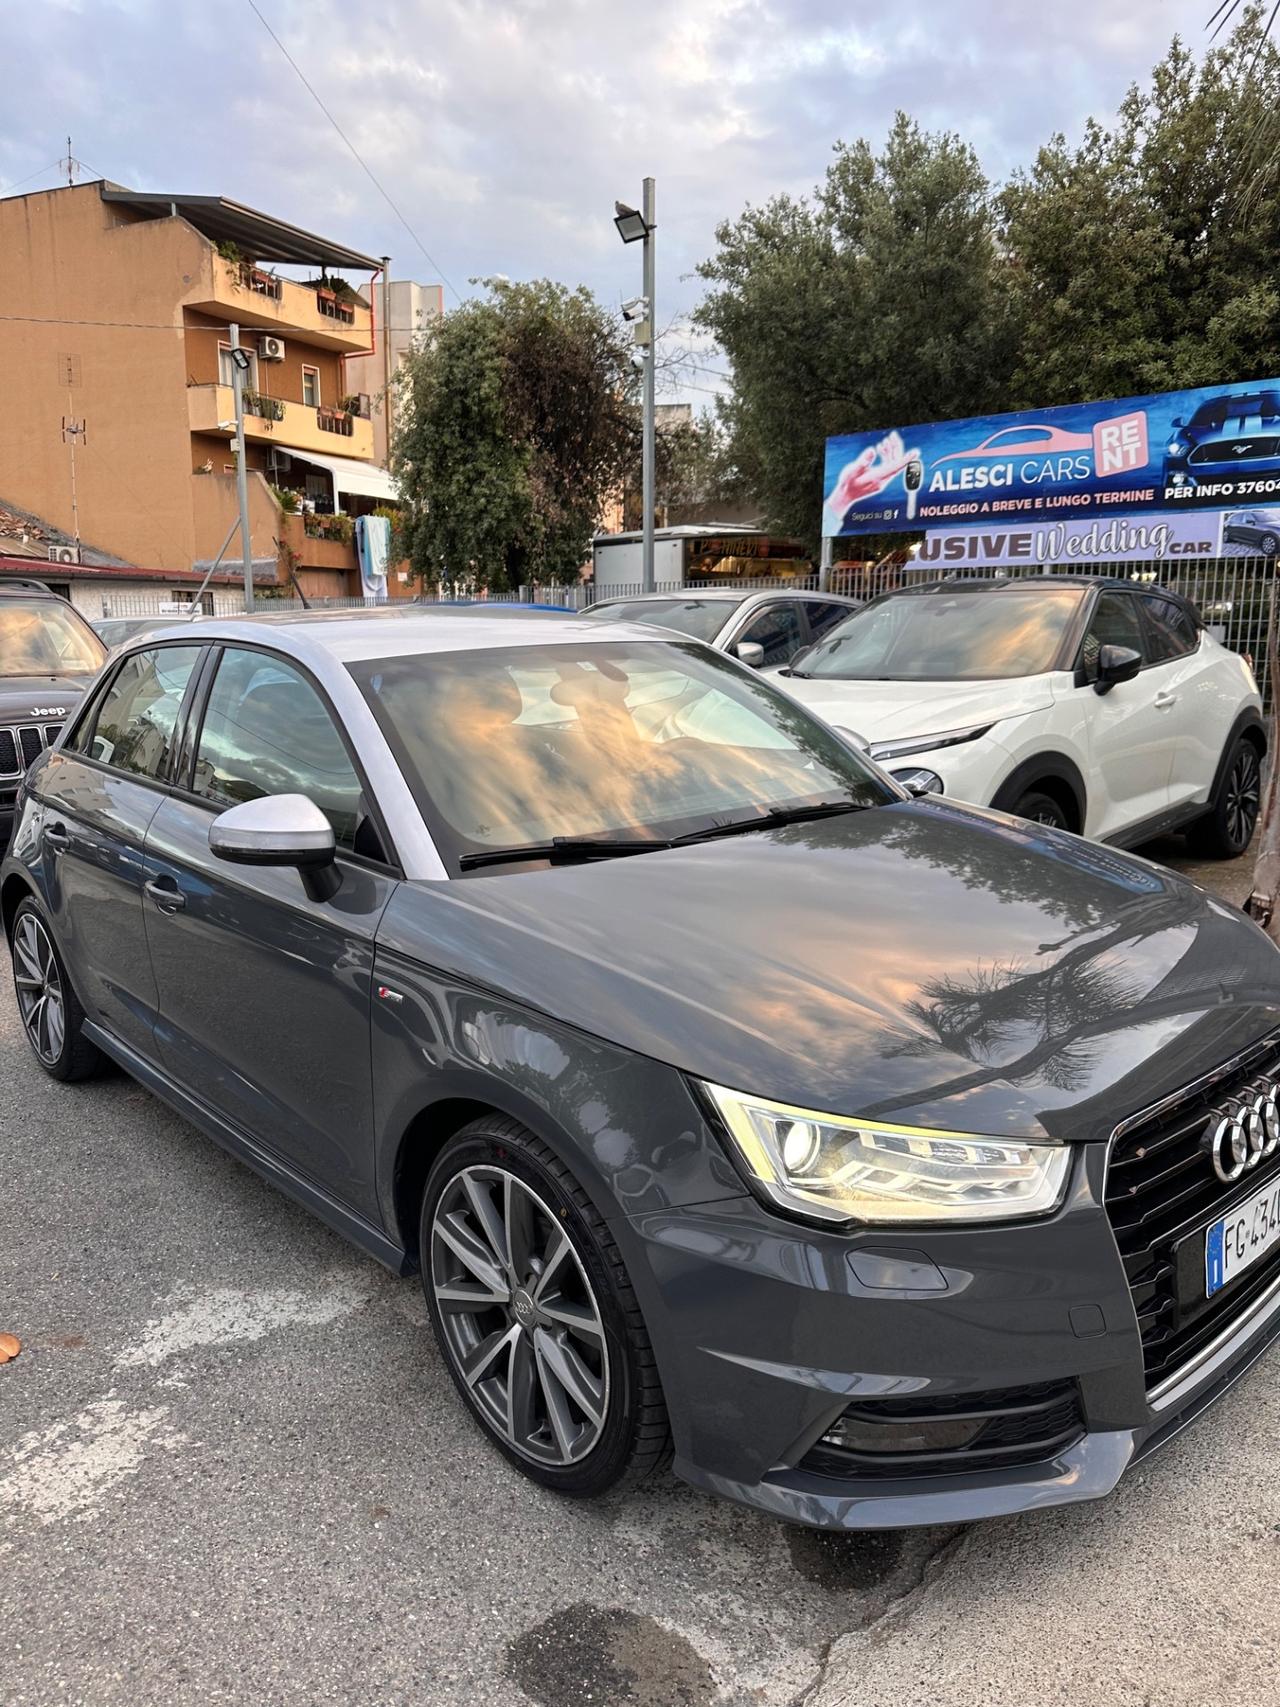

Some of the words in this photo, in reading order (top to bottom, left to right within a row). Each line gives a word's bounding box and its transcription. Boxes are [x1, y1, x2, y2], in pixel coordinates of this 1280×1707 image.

[1101, 419, 1140, 450] RE
[1102, 441, 1142, 471] NT
[929, 463, 1014, 492] ALESCI
[1020, 456, 1091, 484] CARS
[919, 502, 977, 517] NOLEGGIO
[980, 502, 990, 513] A
[992, 498, 1032, 512] BREVE
[1034, 497, 1043, 508] E
[1046, 493, 1091, 507] LUNGO
[1094, 489, 1155, 504] TERMINE
[1164, 487, 1194, 499] PER
[1196, 483, 1234, 497] INFO
[909, 533, 1033, 560] USIVE
[1036, 520, 1175, 561] Wedding
[1169, 542, 1212, 554] CAR
[30, 707, 66, 717] Jeep
